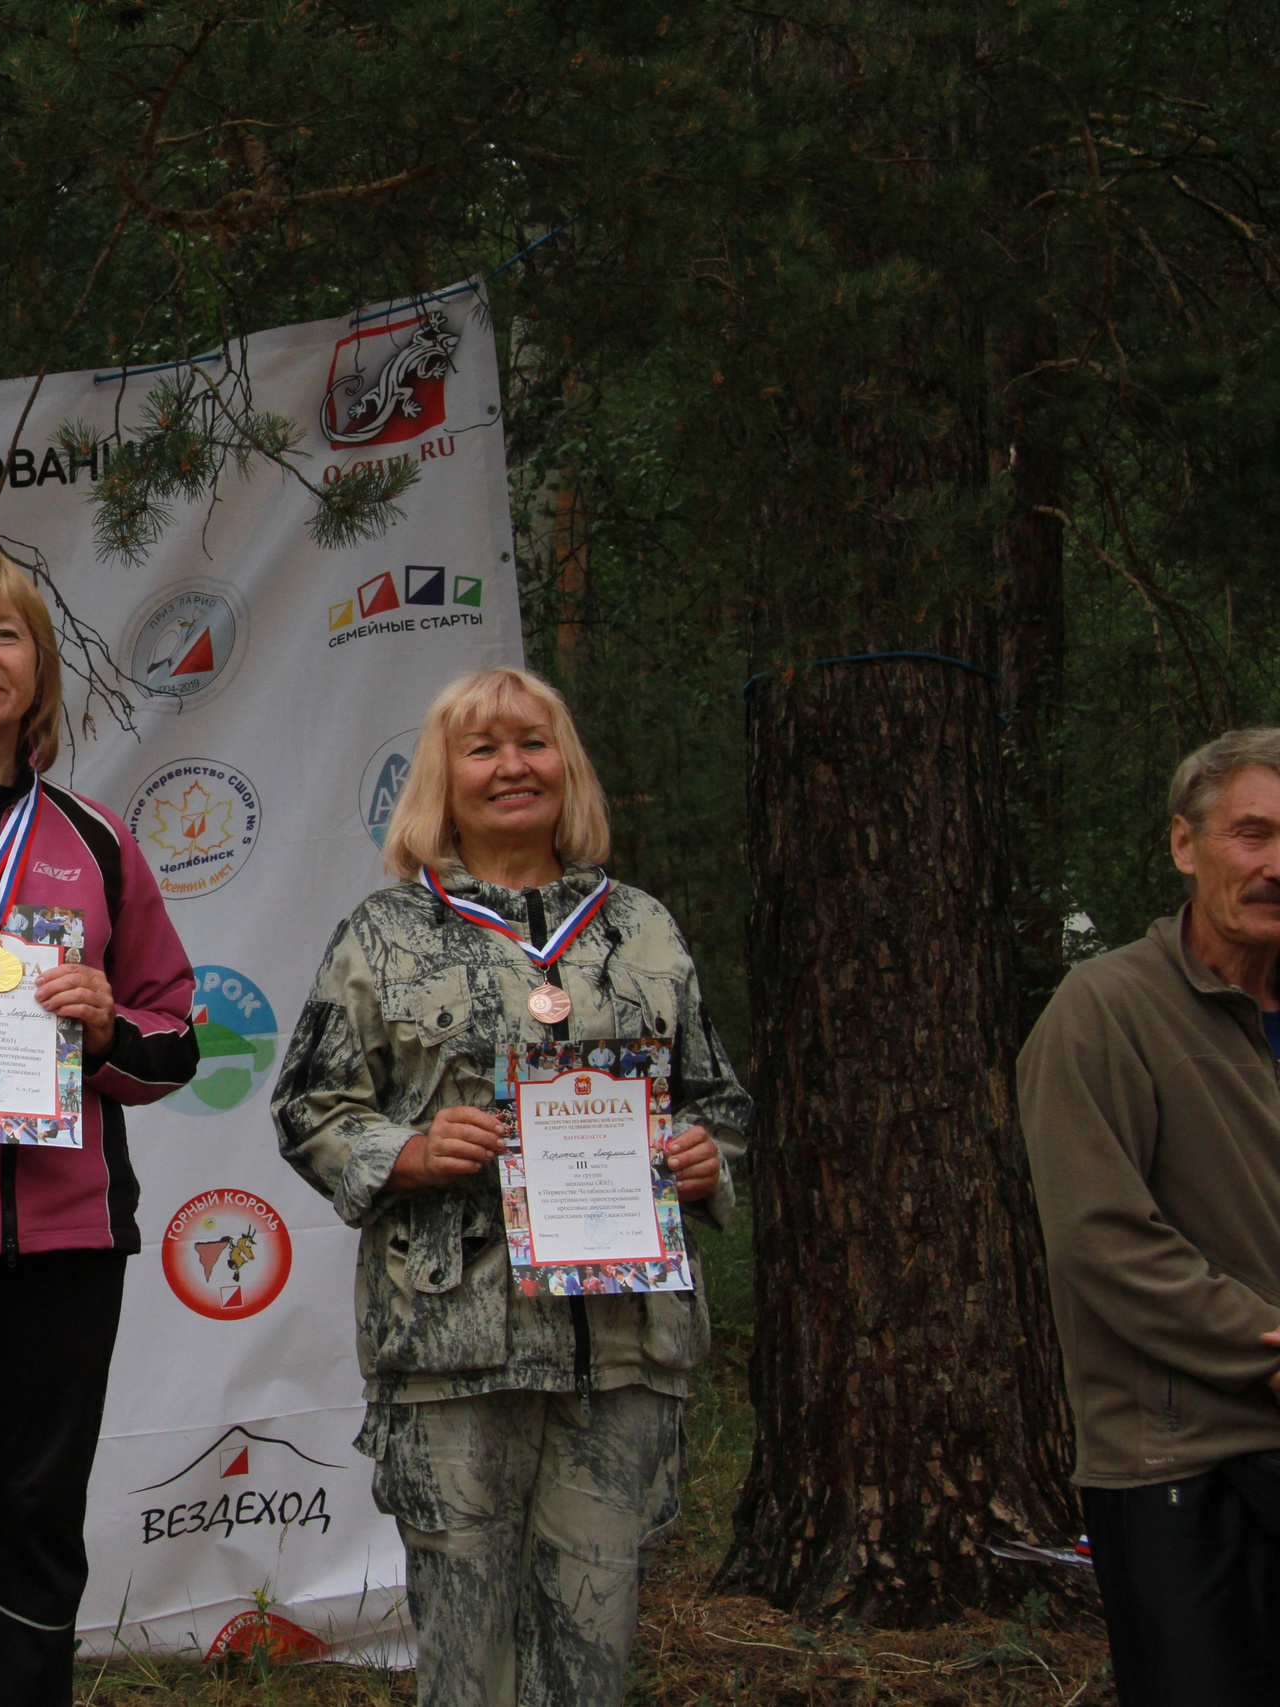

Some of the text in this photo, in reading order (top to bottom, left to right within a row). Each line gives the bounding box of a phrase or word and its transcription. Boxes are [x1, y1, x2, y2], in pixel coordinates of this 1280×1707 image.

[149, 604, 175, 629] ПРИЗ
[328, 613, 483, 648] СЕМЕЙНЫЕ СТАРТЫ
[145, 766, 257, 845] первенство СШОР № 5
[160, 849, 234, 874] Челябинск
[534, 1098, 634, 1117] ГРАМОТА
[167, 1190, 280, 1240] ГОРНЫЙ КОРОЛЬ
[141, 1487, 331, 1544] ВЕЗДЕХОД
